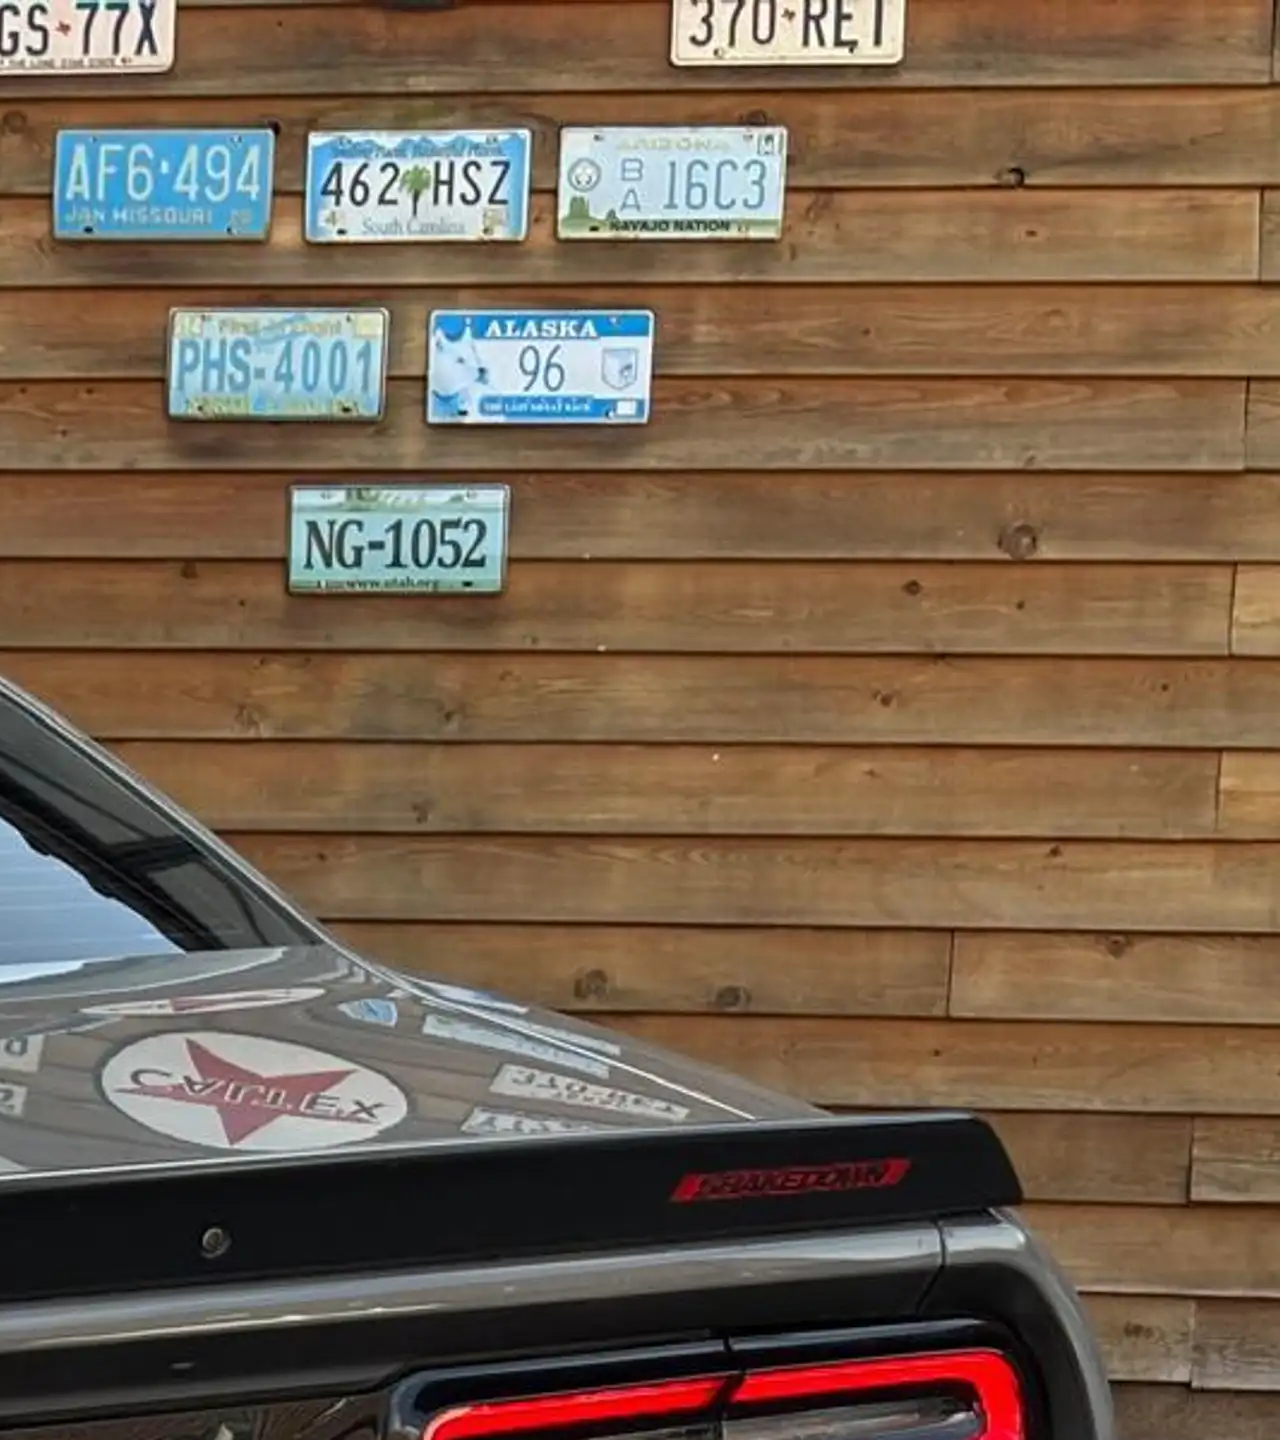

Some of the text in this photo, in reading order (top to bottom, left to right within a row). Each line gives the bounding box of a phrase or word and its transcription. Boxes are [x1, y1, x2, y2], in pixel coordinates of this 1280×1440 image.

[320, 160, 512, 206] 462 HSZ
[662, 158, 767, 211] 16C3
[112, 206, 214, 225] MISSOURI
[362, 216, 405, 235] South
[406, 216, 466, 235] Carolina
[610, 219, 731, 232] NAVAJO NATION
[485, 319, 600, 338] ALASKA
[175, 338, 372, 395] PHS-4001
[519, 344, 566, 392] 96
[303, 517, 488, 570] NG-1052
